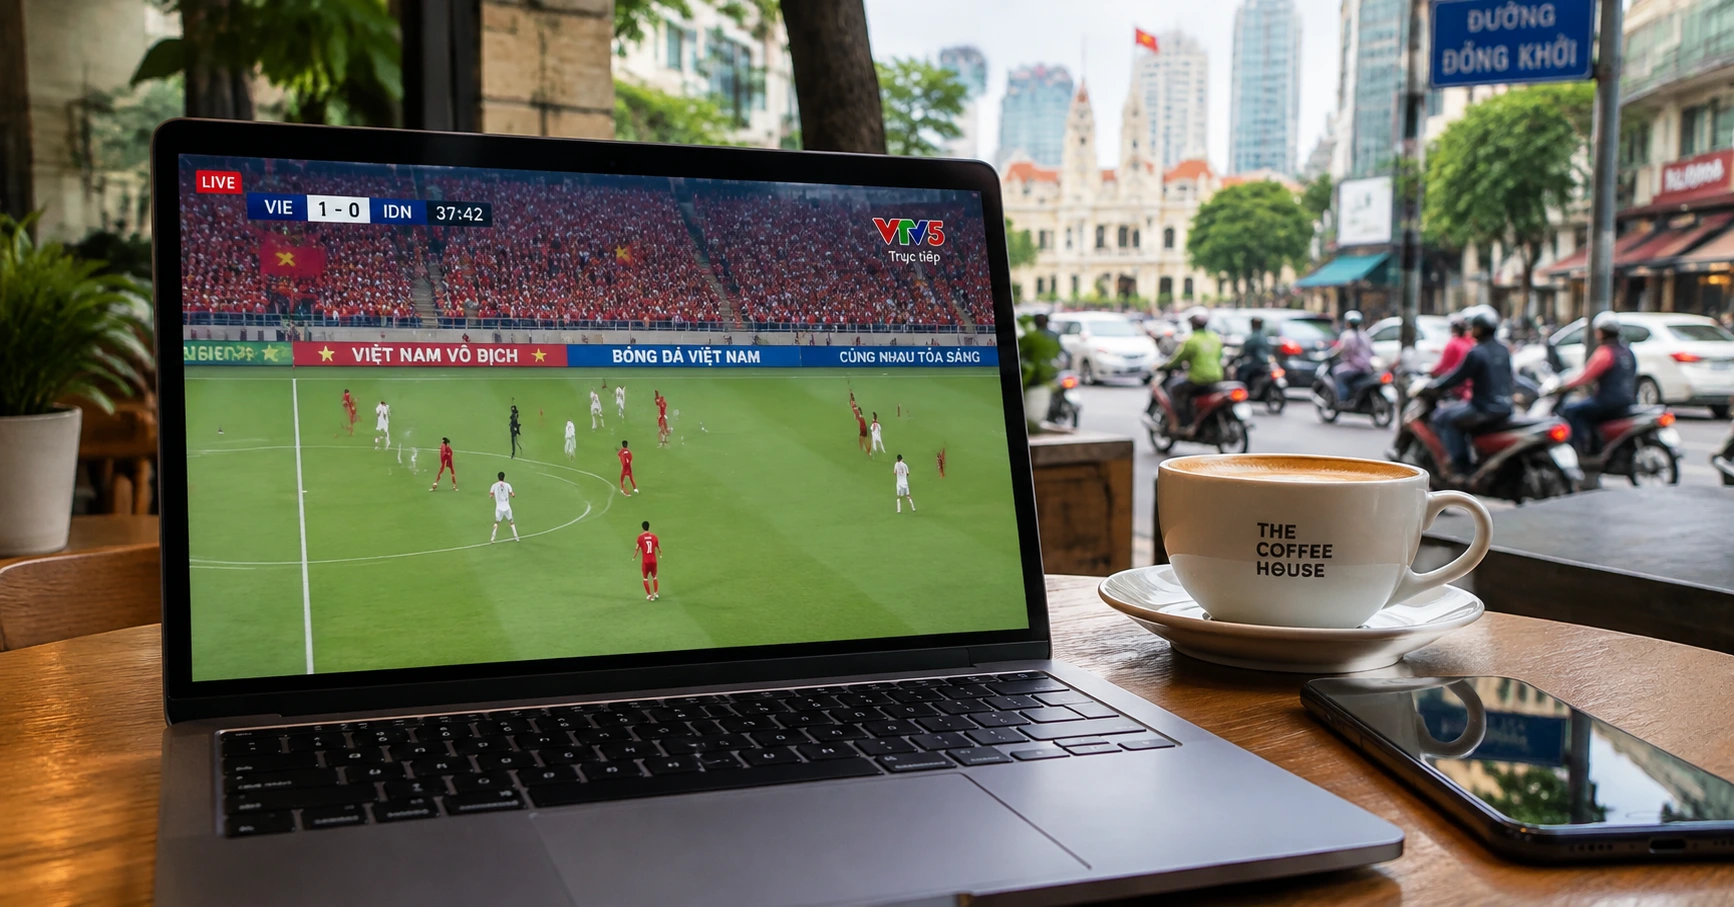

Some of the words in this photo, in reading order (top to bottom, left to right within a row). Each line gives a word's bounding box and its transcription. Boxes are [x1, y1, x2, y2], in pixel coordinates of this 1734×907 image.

[201, 175, 236, 190] LIVE
[264, 199, 293, 215] VIE
[318, 201, 326, 217] 1
[349, 202, 360, 218] 0
[383, 204, 412, 219] IDN
[435, 206, 484, 222] 37:42
[872, 217, 945, 246] VTV5
[400, 347, 442, 362] NAM
[446, 344, 472, 363] VÔ
[477, 347, 519, 366] ĐỊCH
[726, 350, 761, 363] NAM
[879, 351, 915, 363] NHAU
[1257, 522, 1297, 540] THE
[1256, 541, 1333, 559] COFFEE
[1256, 561, 1325, 578] HOUSE
